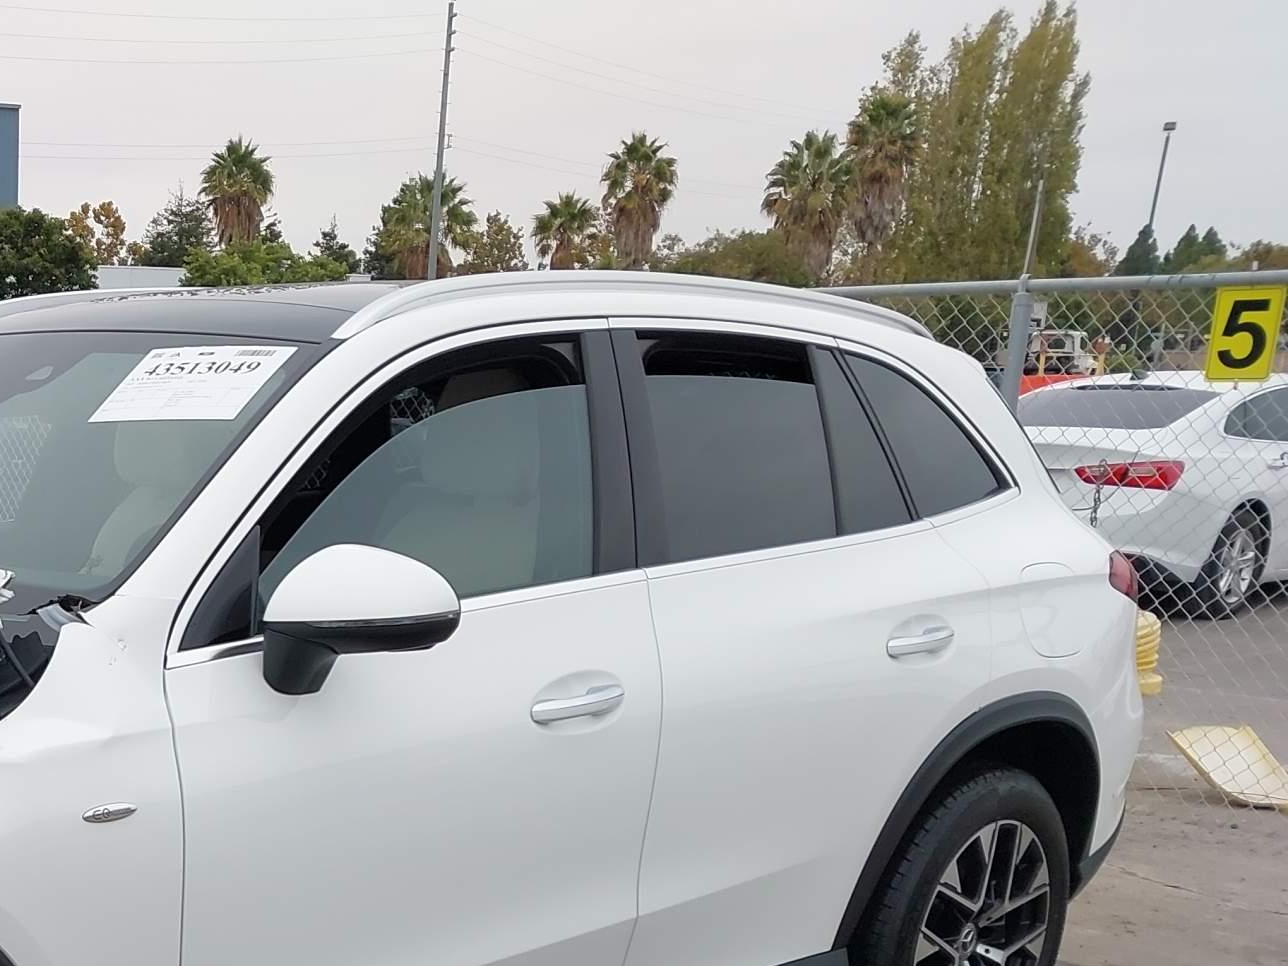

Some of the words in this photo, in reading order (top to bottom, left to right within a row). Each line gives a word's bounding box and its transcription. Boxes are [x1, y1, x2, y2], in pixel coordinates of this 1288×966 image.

[1217, 299, 1272, 369] 5
[144, 361, 262, 376] 43513049
[93, 808, 111, 820] EQ
